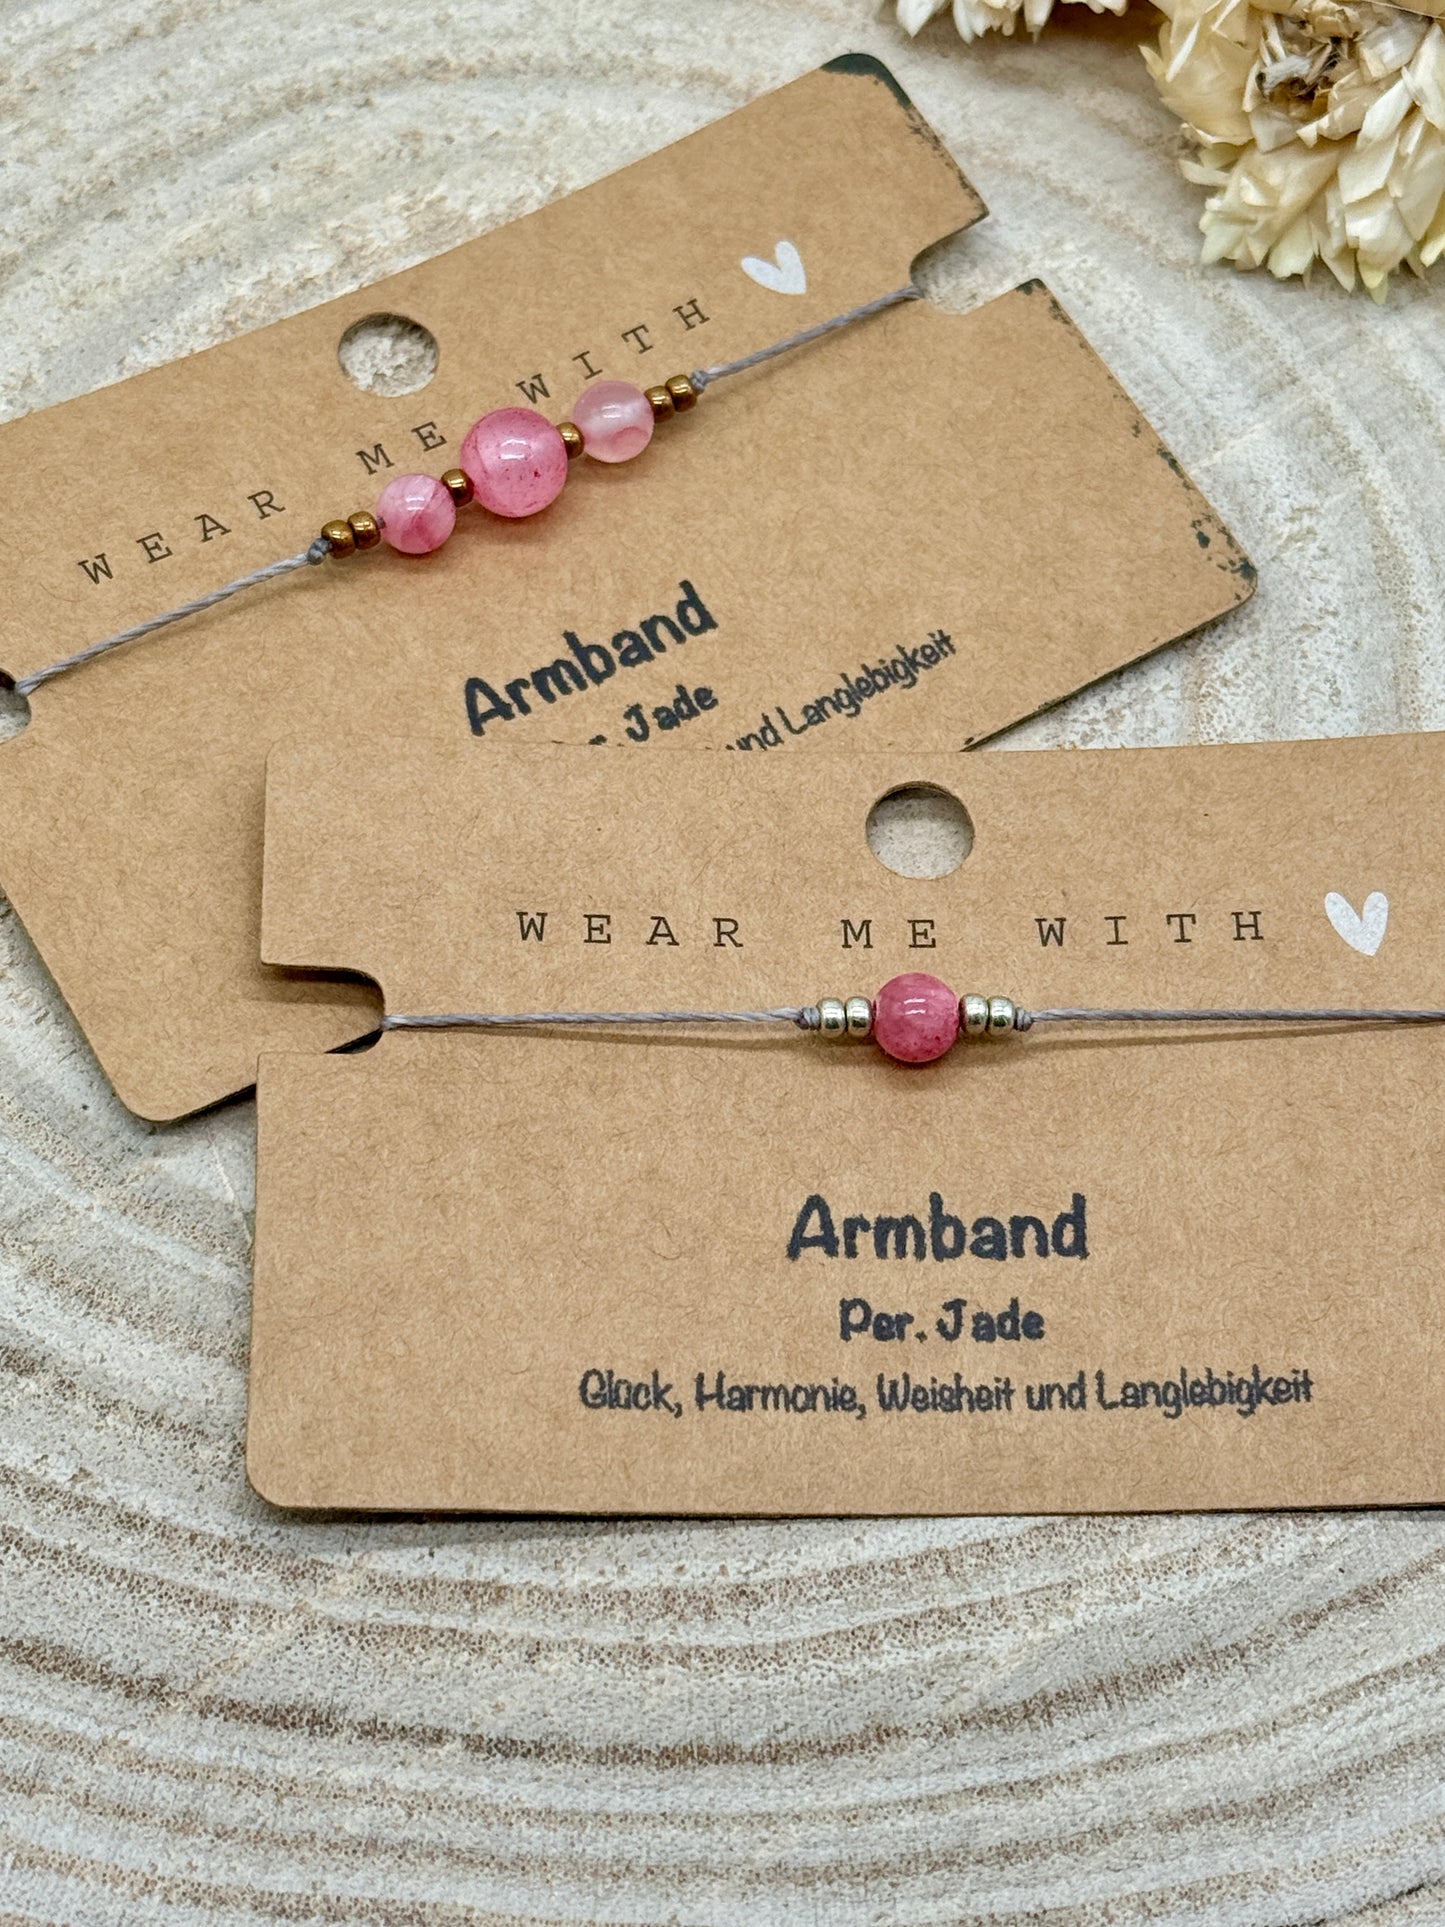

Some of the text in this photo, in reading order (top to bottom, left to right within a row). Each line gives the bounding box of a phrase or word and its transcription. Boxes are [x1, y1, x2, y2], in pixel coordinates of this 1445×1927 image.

[77, 298, 711, 585] WEAR ME WITH
[464, 579, 719, 736] Armband
[775, 629, 957, 735] Langlebigkeit
[622, 685, 719, 742] Jade
[516, 910, 1265, 949] WEAR ME WITH
[785, 1191, 1091, 1262] Armband
[839, 1296, 1045, 1343] Per. Jade
[694, 1369, 868, 1420] Harmonie,
[876, 1371, 1016, 1414] Weisheit
[1026, 1369, 1088, 1411] und
[1095, 1363, 1315, 1419] Langlebigkeit
